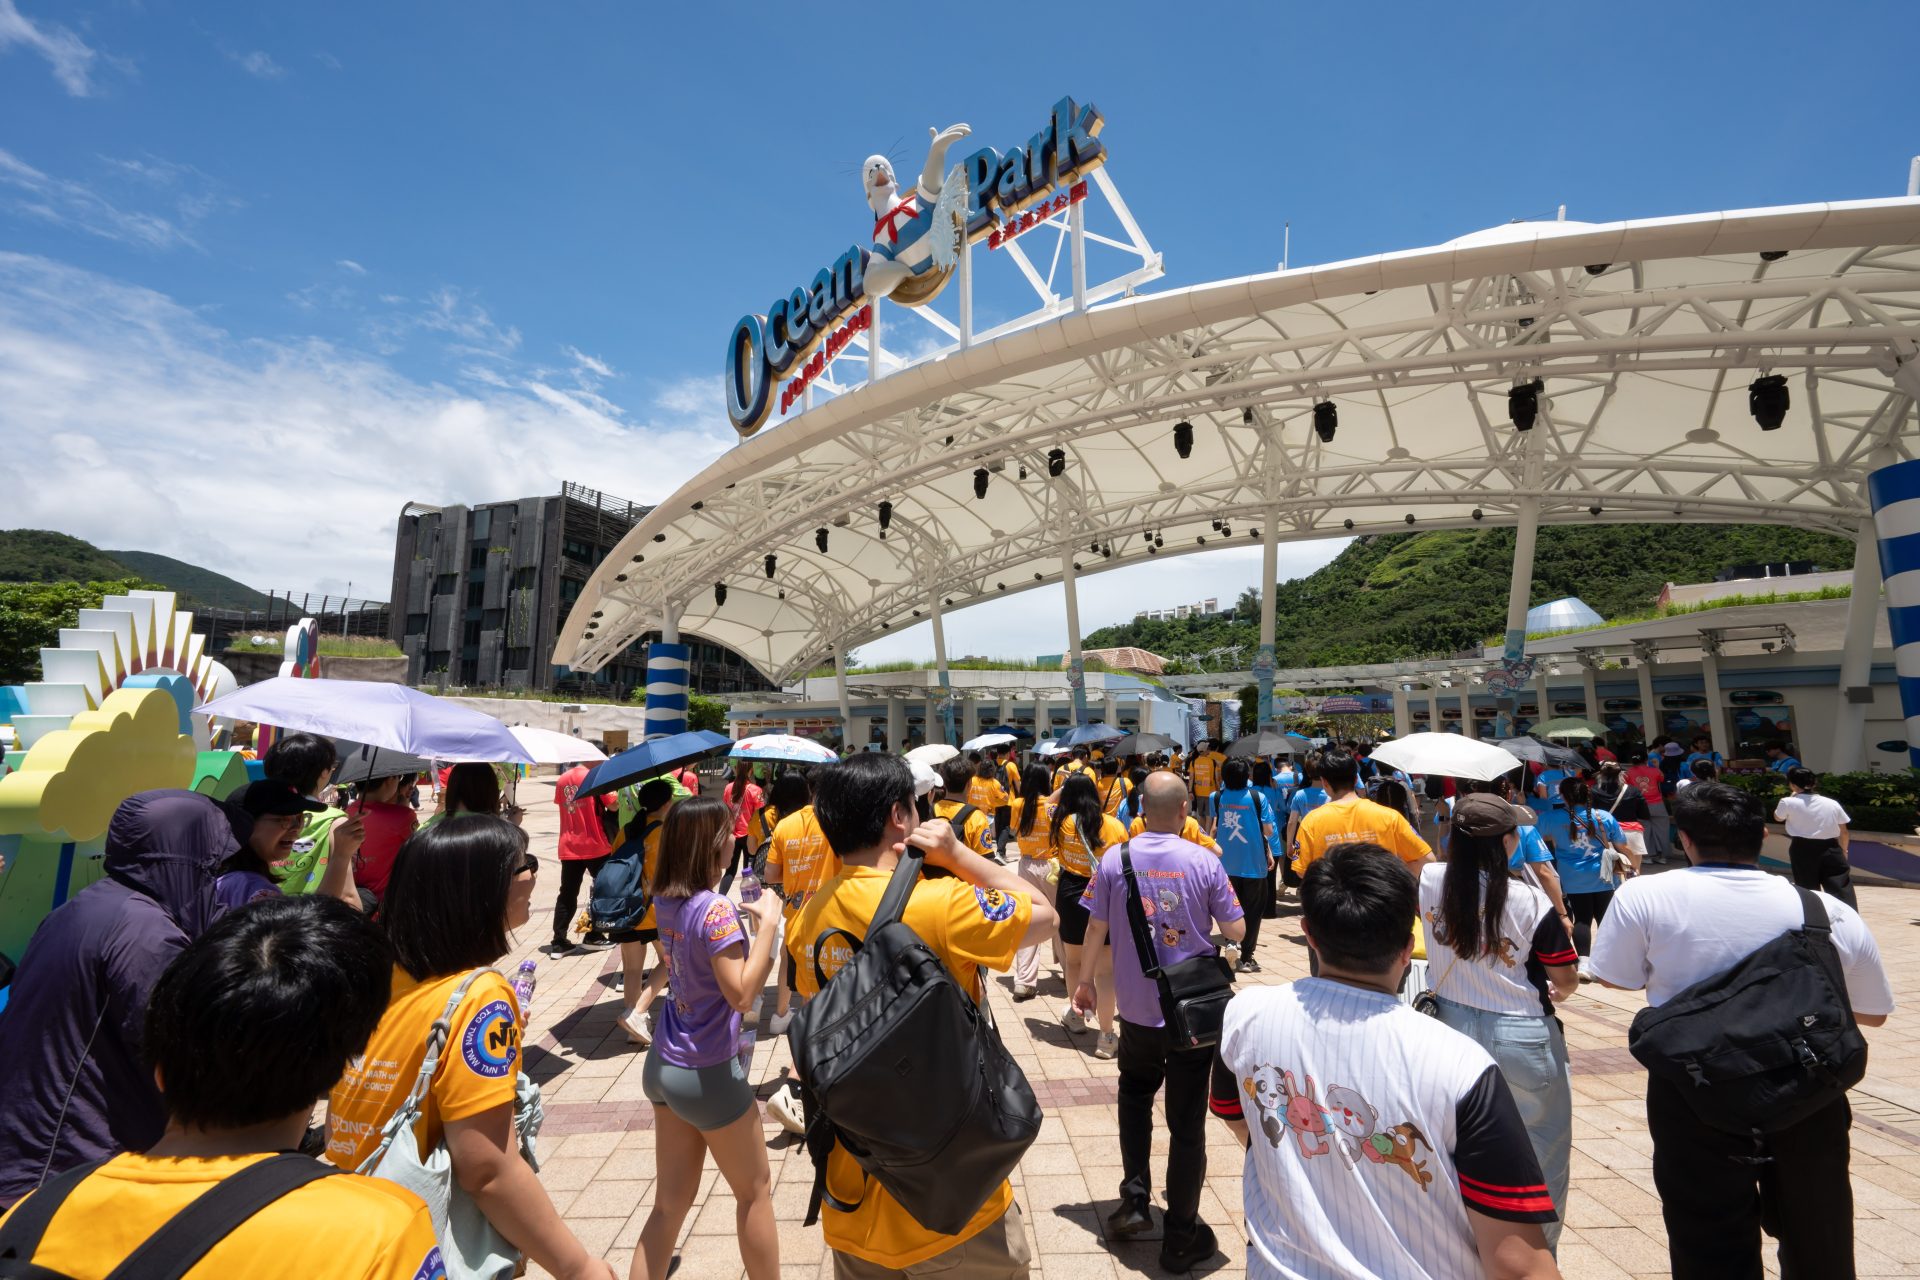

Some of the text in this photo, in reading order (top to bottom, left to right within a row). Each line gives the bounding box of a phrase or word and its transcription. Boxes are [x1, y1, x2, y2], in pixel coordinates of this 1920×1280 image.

[726, 95, 1106, 434] Ocean Park
[805, 943, 828, 960] 10%
[475, 1008, 491, 1024] TCG
[481, 1063, 498, 1075] TMN
[364, 1081, 393, 1093] CONCE
